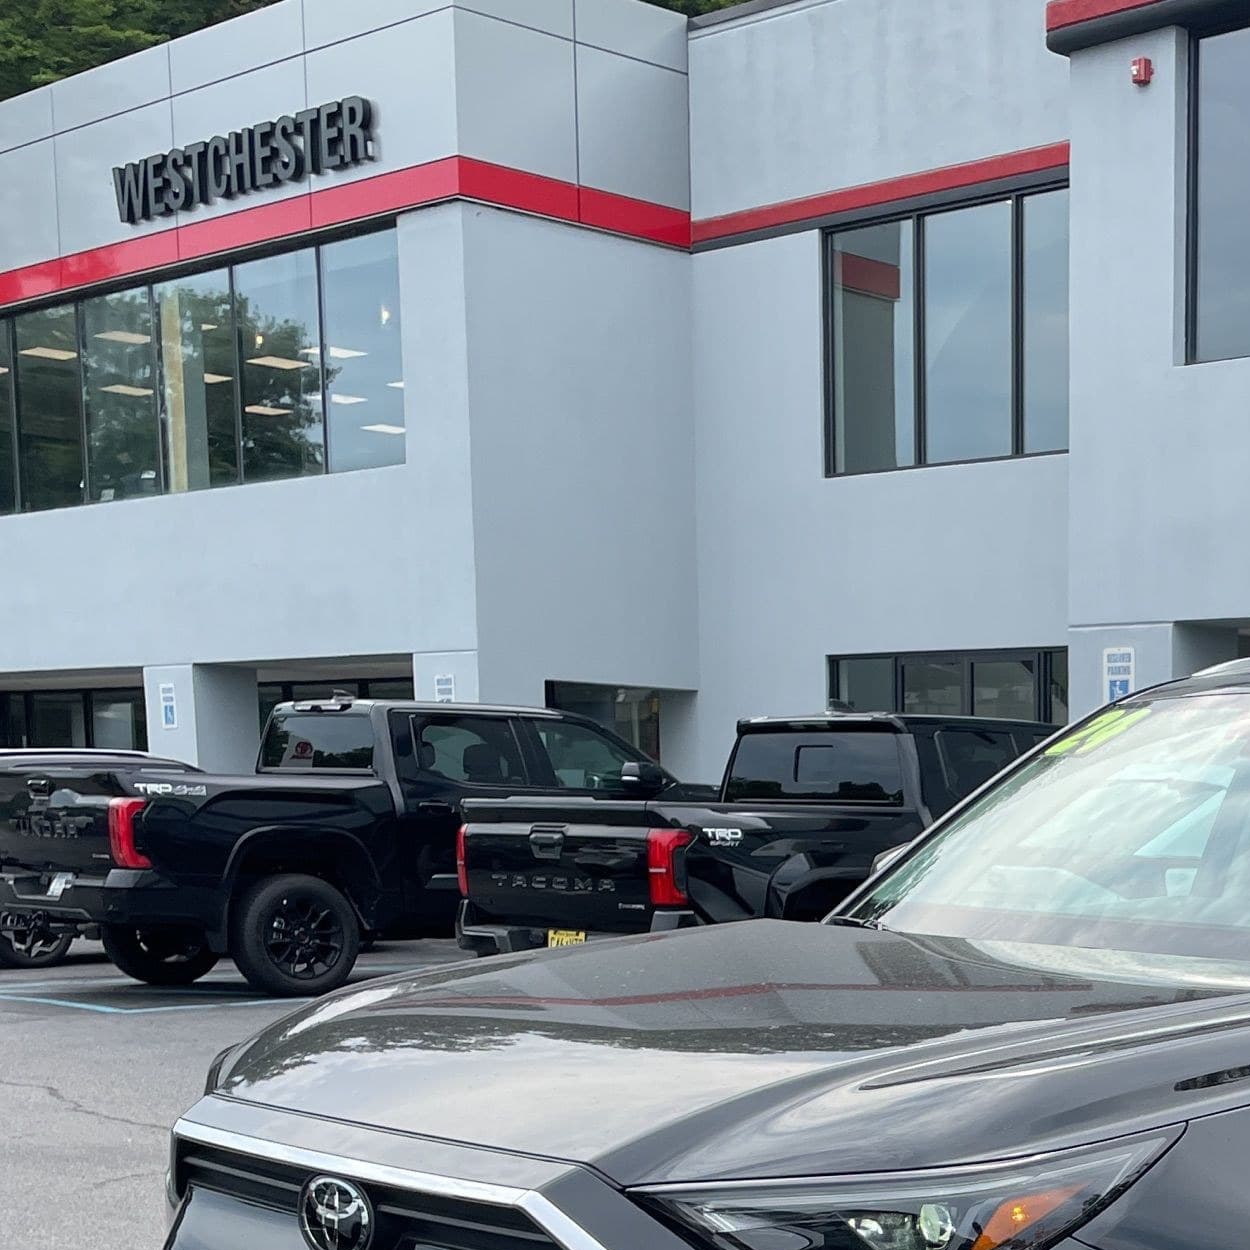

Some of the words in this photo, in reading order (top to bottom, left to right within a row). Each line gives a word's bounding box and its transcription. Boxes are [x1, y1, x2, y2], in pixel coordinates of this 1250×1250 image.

[112, 96, 373, 223] WESTCHESTER
[134, 783, 172, 795] TRD
[702, 828, 743, 841] TRD
[491, 872, 617, 892] TACOMA
